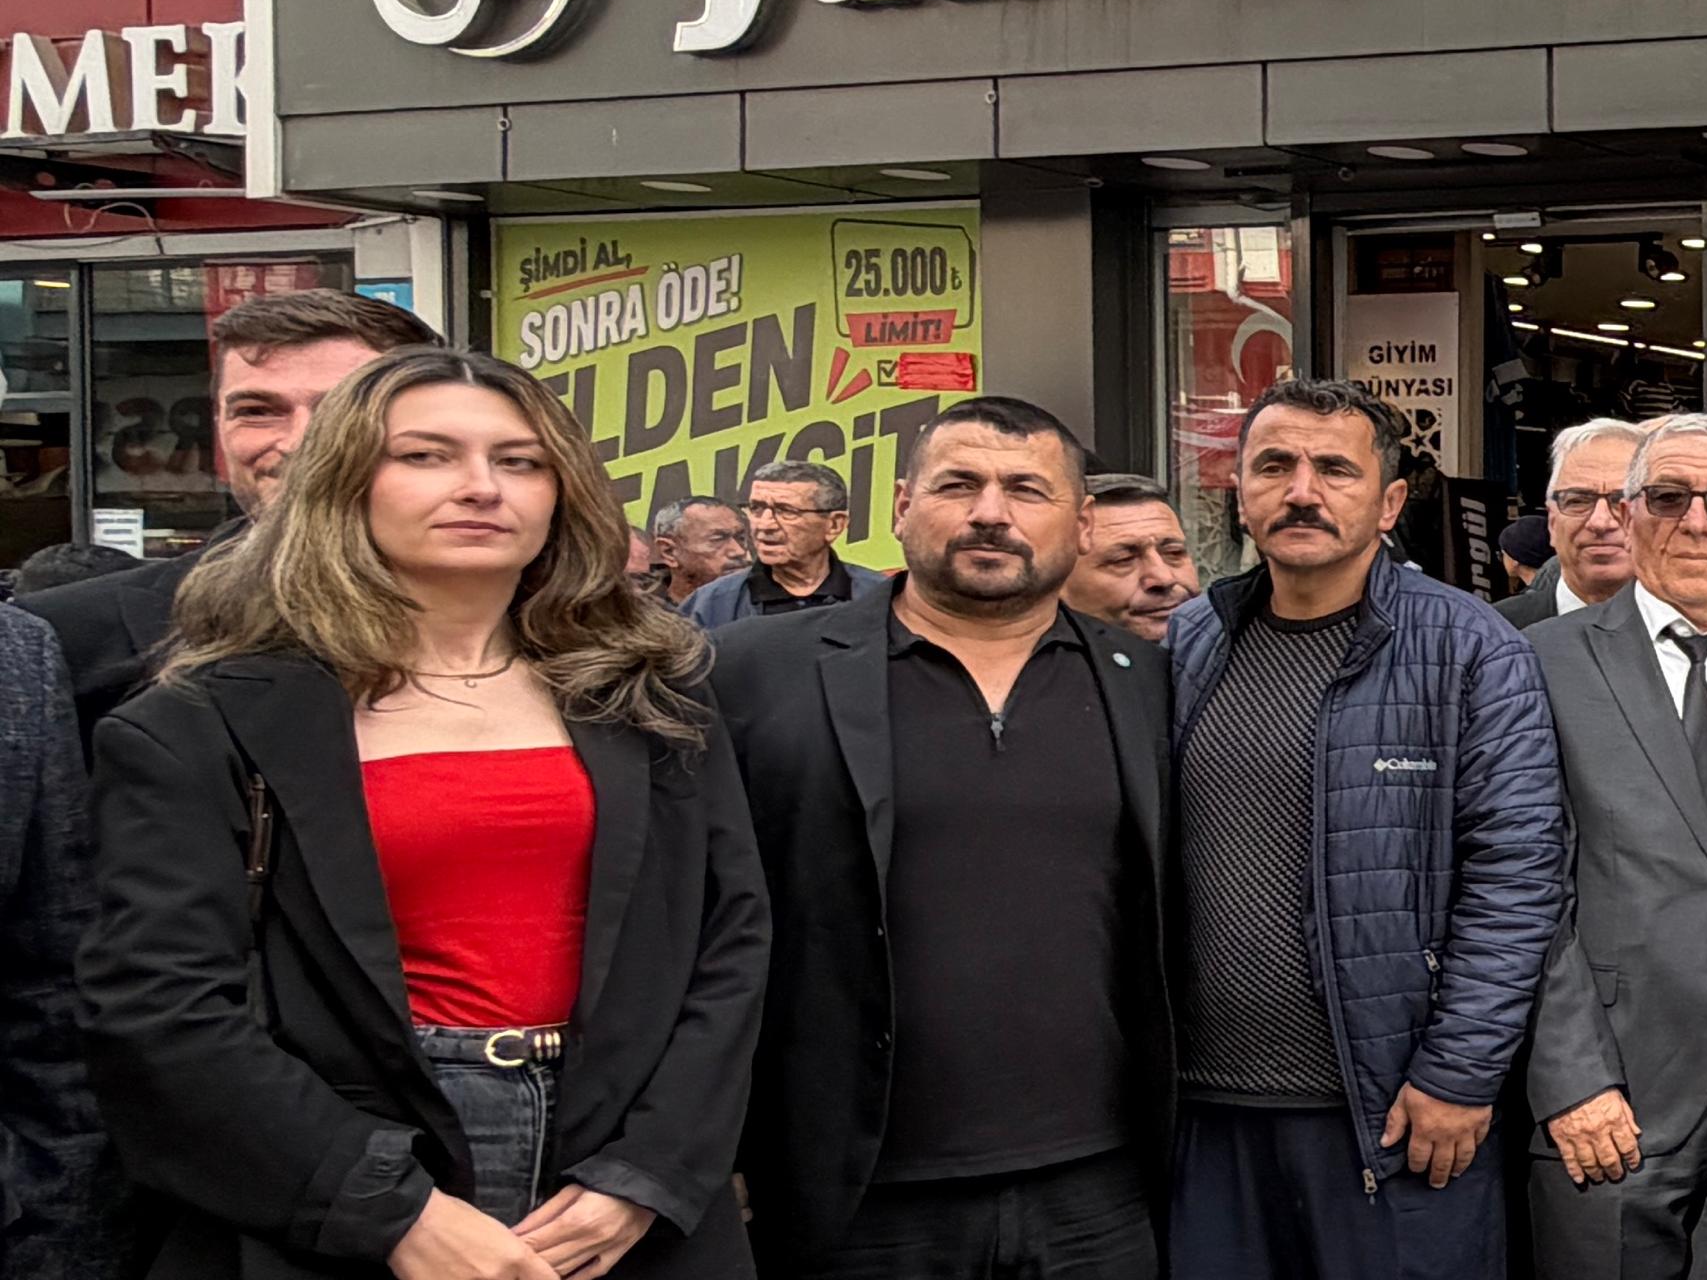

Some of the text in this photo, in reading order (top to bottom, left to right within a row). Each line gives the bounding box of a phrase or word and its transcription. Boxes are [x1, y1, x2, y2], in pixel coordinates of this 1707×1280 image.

[519, 237, 633, 293] ŞİMDİ AL,
[519, 253, 742, 370] SONRA ÖDE!
[864, 312, 942, 344] LİMİT!
[1368, 340, 1436, 364] GİYİM
